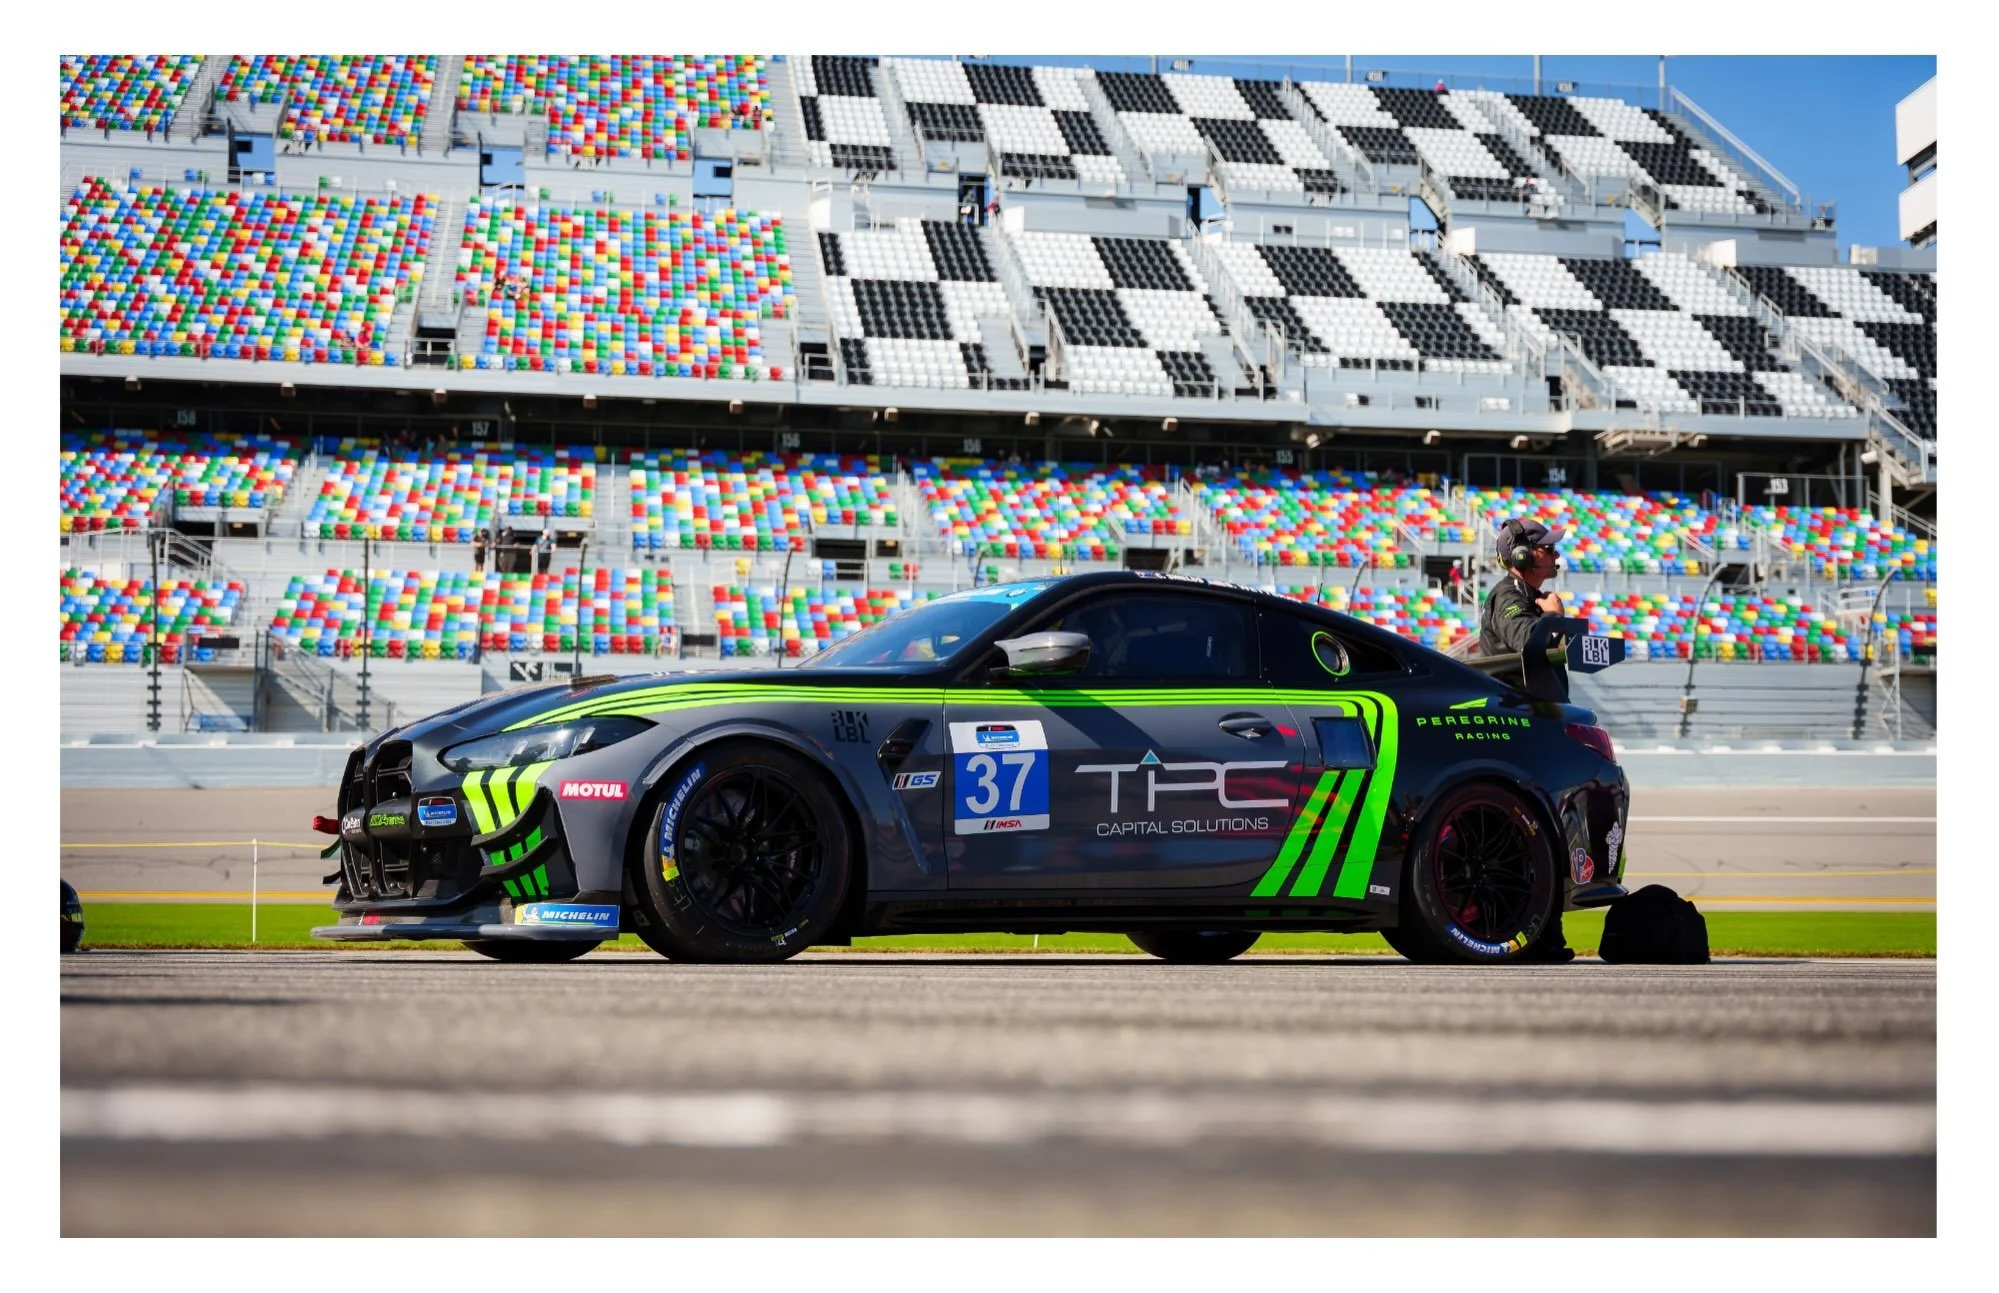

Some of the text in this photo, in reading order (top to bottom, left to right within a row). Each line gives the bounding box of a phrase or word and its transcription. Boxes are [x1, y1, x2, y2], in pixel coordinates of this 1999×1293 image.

[177, 409, 196, 425] 158
[472, 421, 490, 436] 157
[1584, 638, 1608, 650] BLK
[1585, 650, 1607, 663] LBL
[1416, 715, 1531, 727] PEREGRINE
[834, 725, 871, 743] LBL
[1455, 732, 1511, 740] RACING
[911, 774, 936, 786] GS
[965, 751, 1035, 814] 37
[1074, 759, 1289, 813] TPC
[562, 783, 624, 798] MOTUL
[664, 768, 701, 842] MICHELIN
[996, 820, 1022, 829] IMSA
[1096, 817, 1269, 836] CAPITAL SOLUTIONS
[541, 910, 610, 920] MICHELIN
[1451, 928, 1500, 953] MICHELIN
